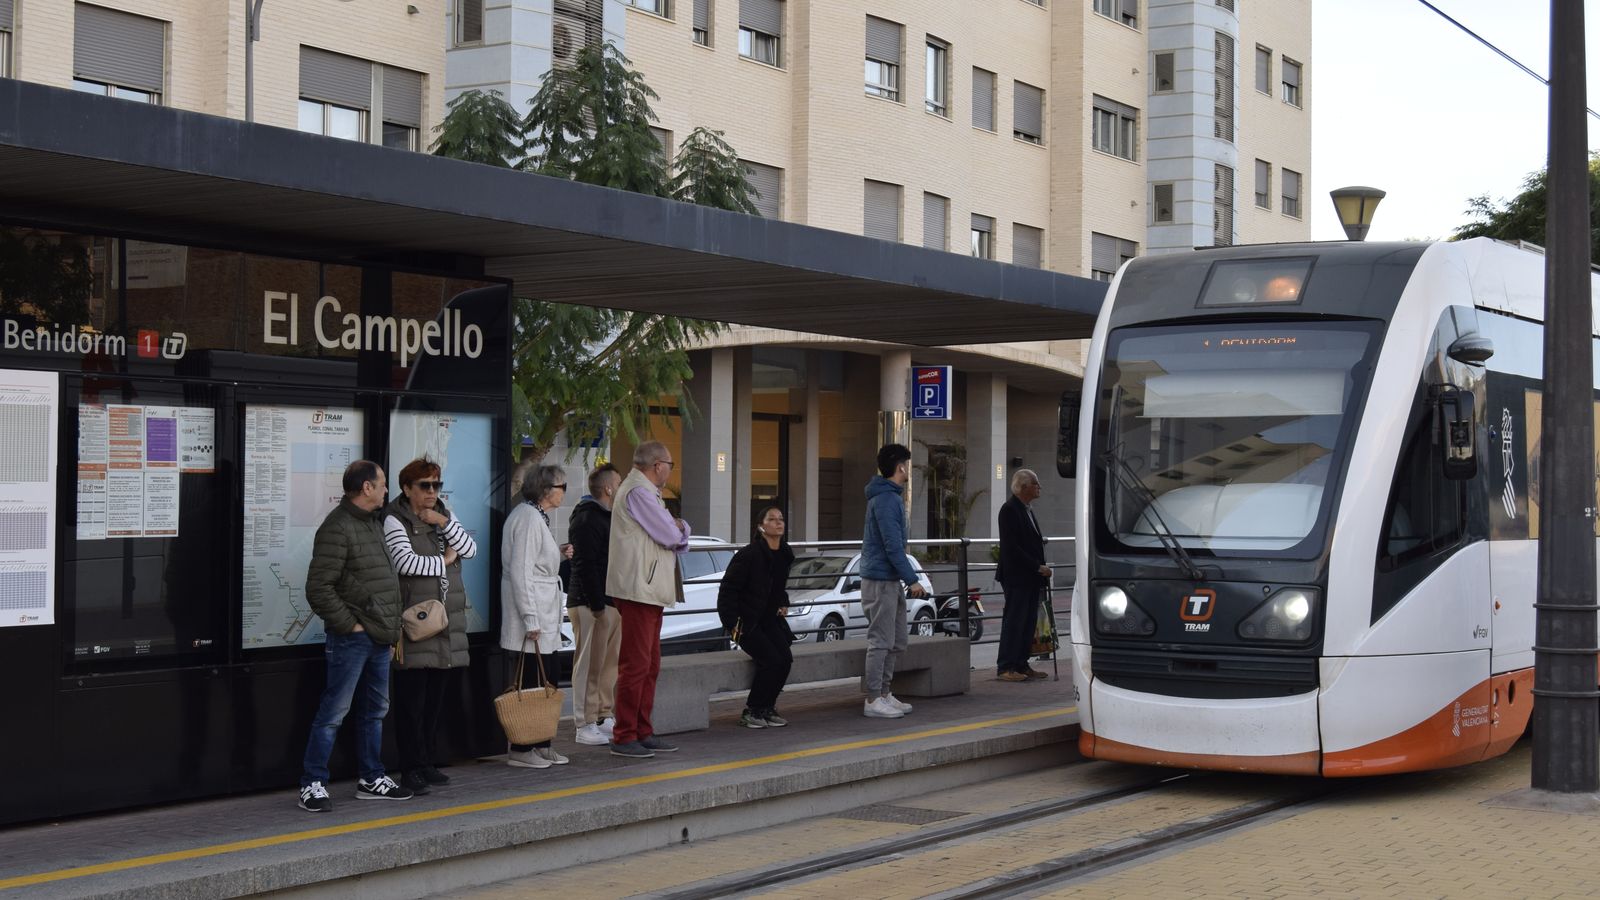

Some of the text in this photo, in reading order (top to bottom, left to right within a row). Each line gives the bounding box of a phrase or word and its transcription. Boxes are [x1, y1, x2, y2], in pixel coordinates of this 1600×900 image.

[4, 319, 126, 356] Benidorm
[144, 335, 151, 352] 1
[264, 290, 483, 368] El Campello
[924, 387, 934, 404] P
[324, 413, 343, 421] TRAM
